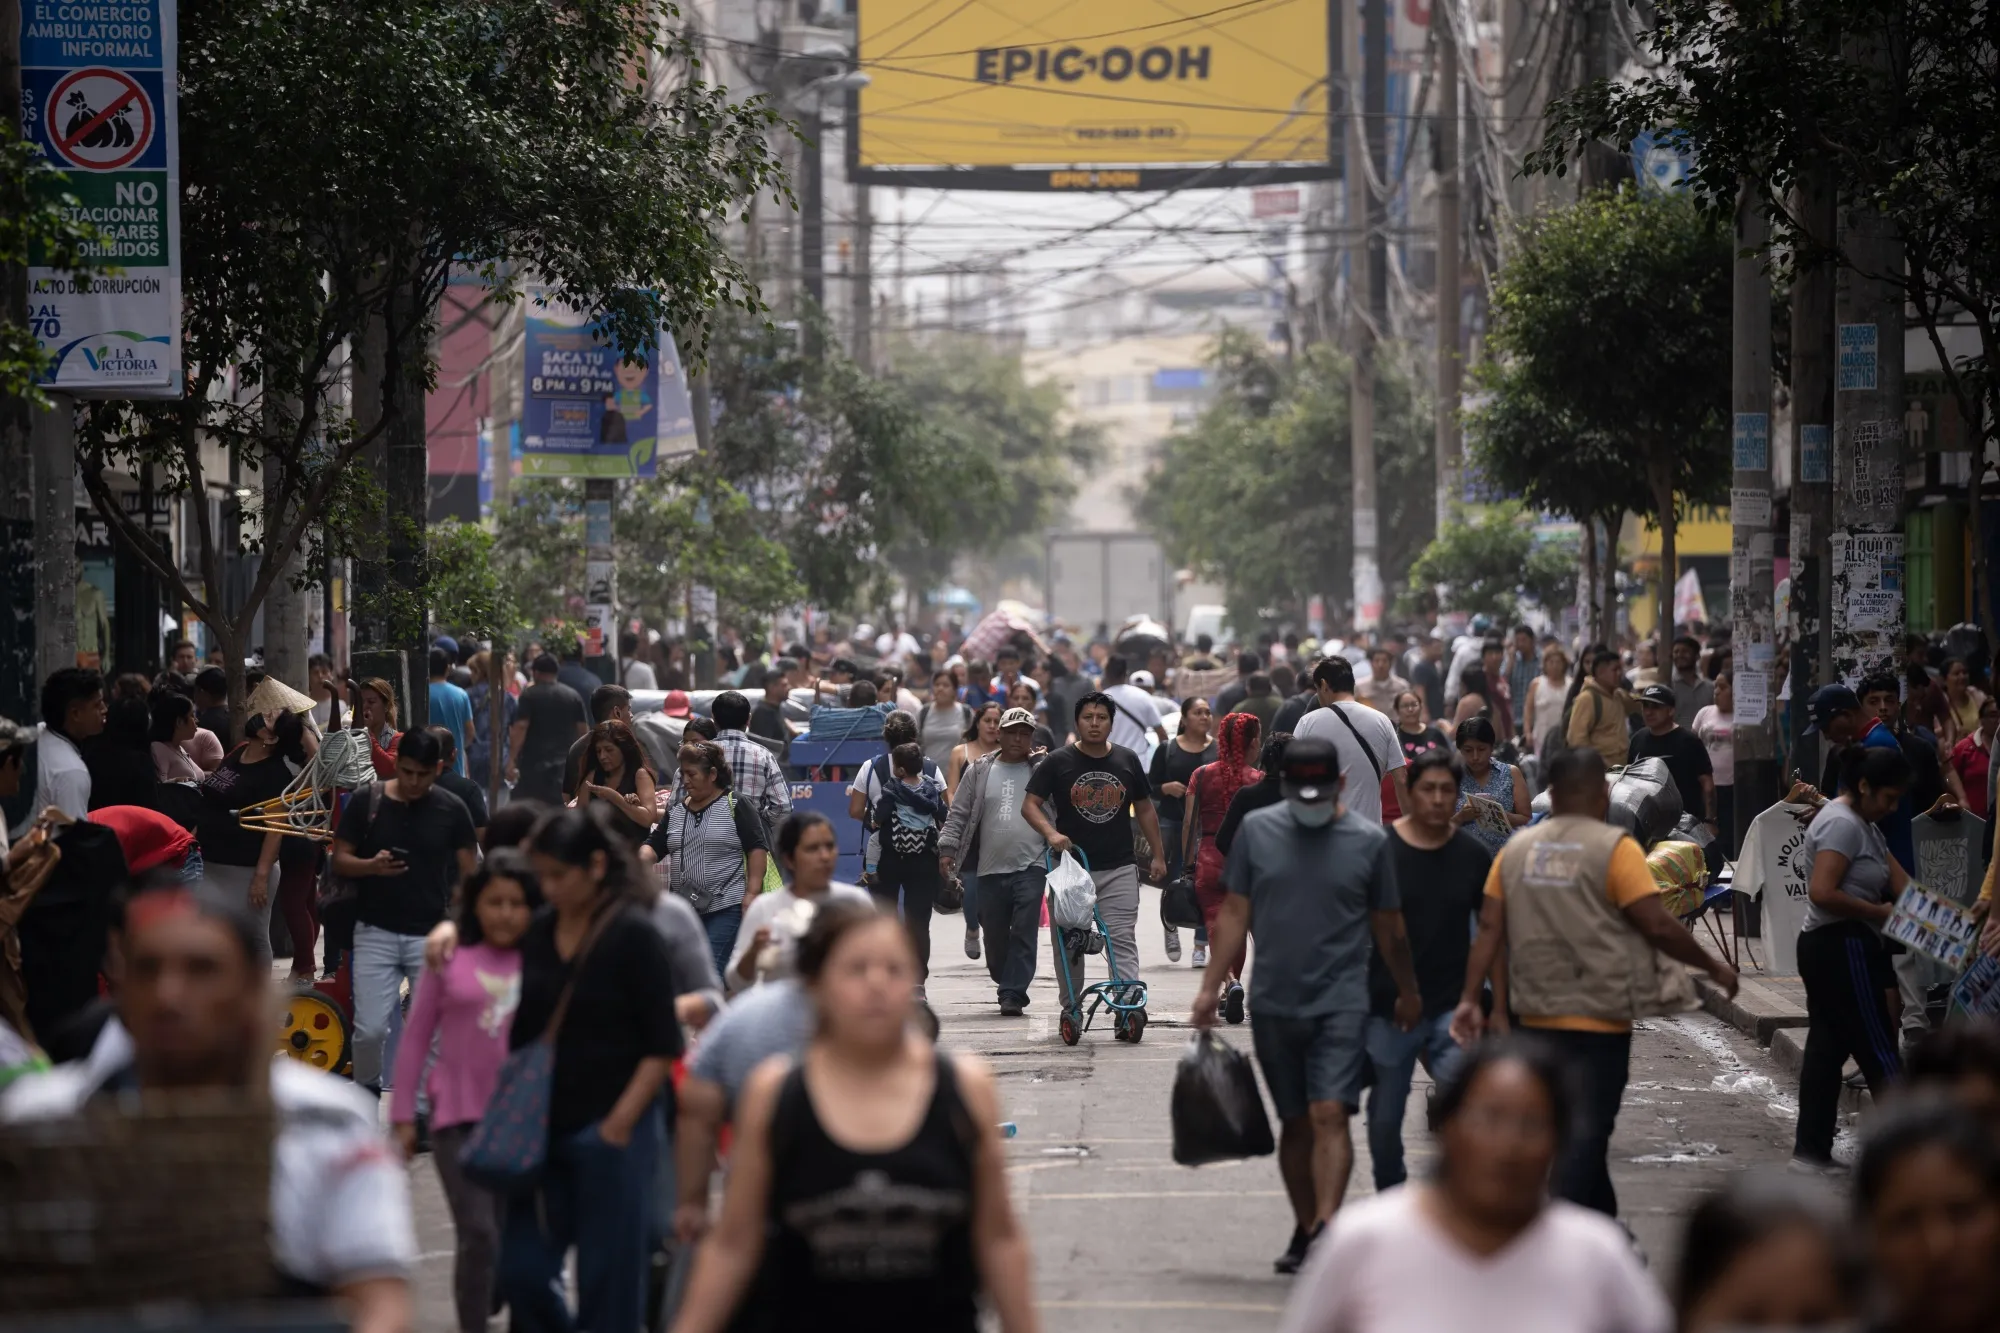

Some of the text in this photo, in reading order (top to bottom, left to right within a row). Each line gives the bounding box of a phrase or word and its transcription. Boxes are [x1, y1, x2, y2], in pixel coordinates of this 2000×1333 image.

[35, 5, 151, 22] EL COMERCIO
[27, 23, 152, 40] AMBULATORIO
[62, 42, 154, 57] INFORMAL
[116, 182, 158, 205] NO
[58, 207, 159, 222] STACIONAR
[39, 305, 60, 317] AL
[116, 349, 133, 359] LA
[542, 351, 604, 366] SACA TU
[1841, 352, 1876, 366] AMARRES
[542, 364, 599, 378] BASURA
[532, 376, 543, 392] 8
[545, 379, 566, 391] PM
[580, 378, 592, 393] 9
[1008, 711, 1030, 722] UFC
[791, 784, 813, 799] 156
